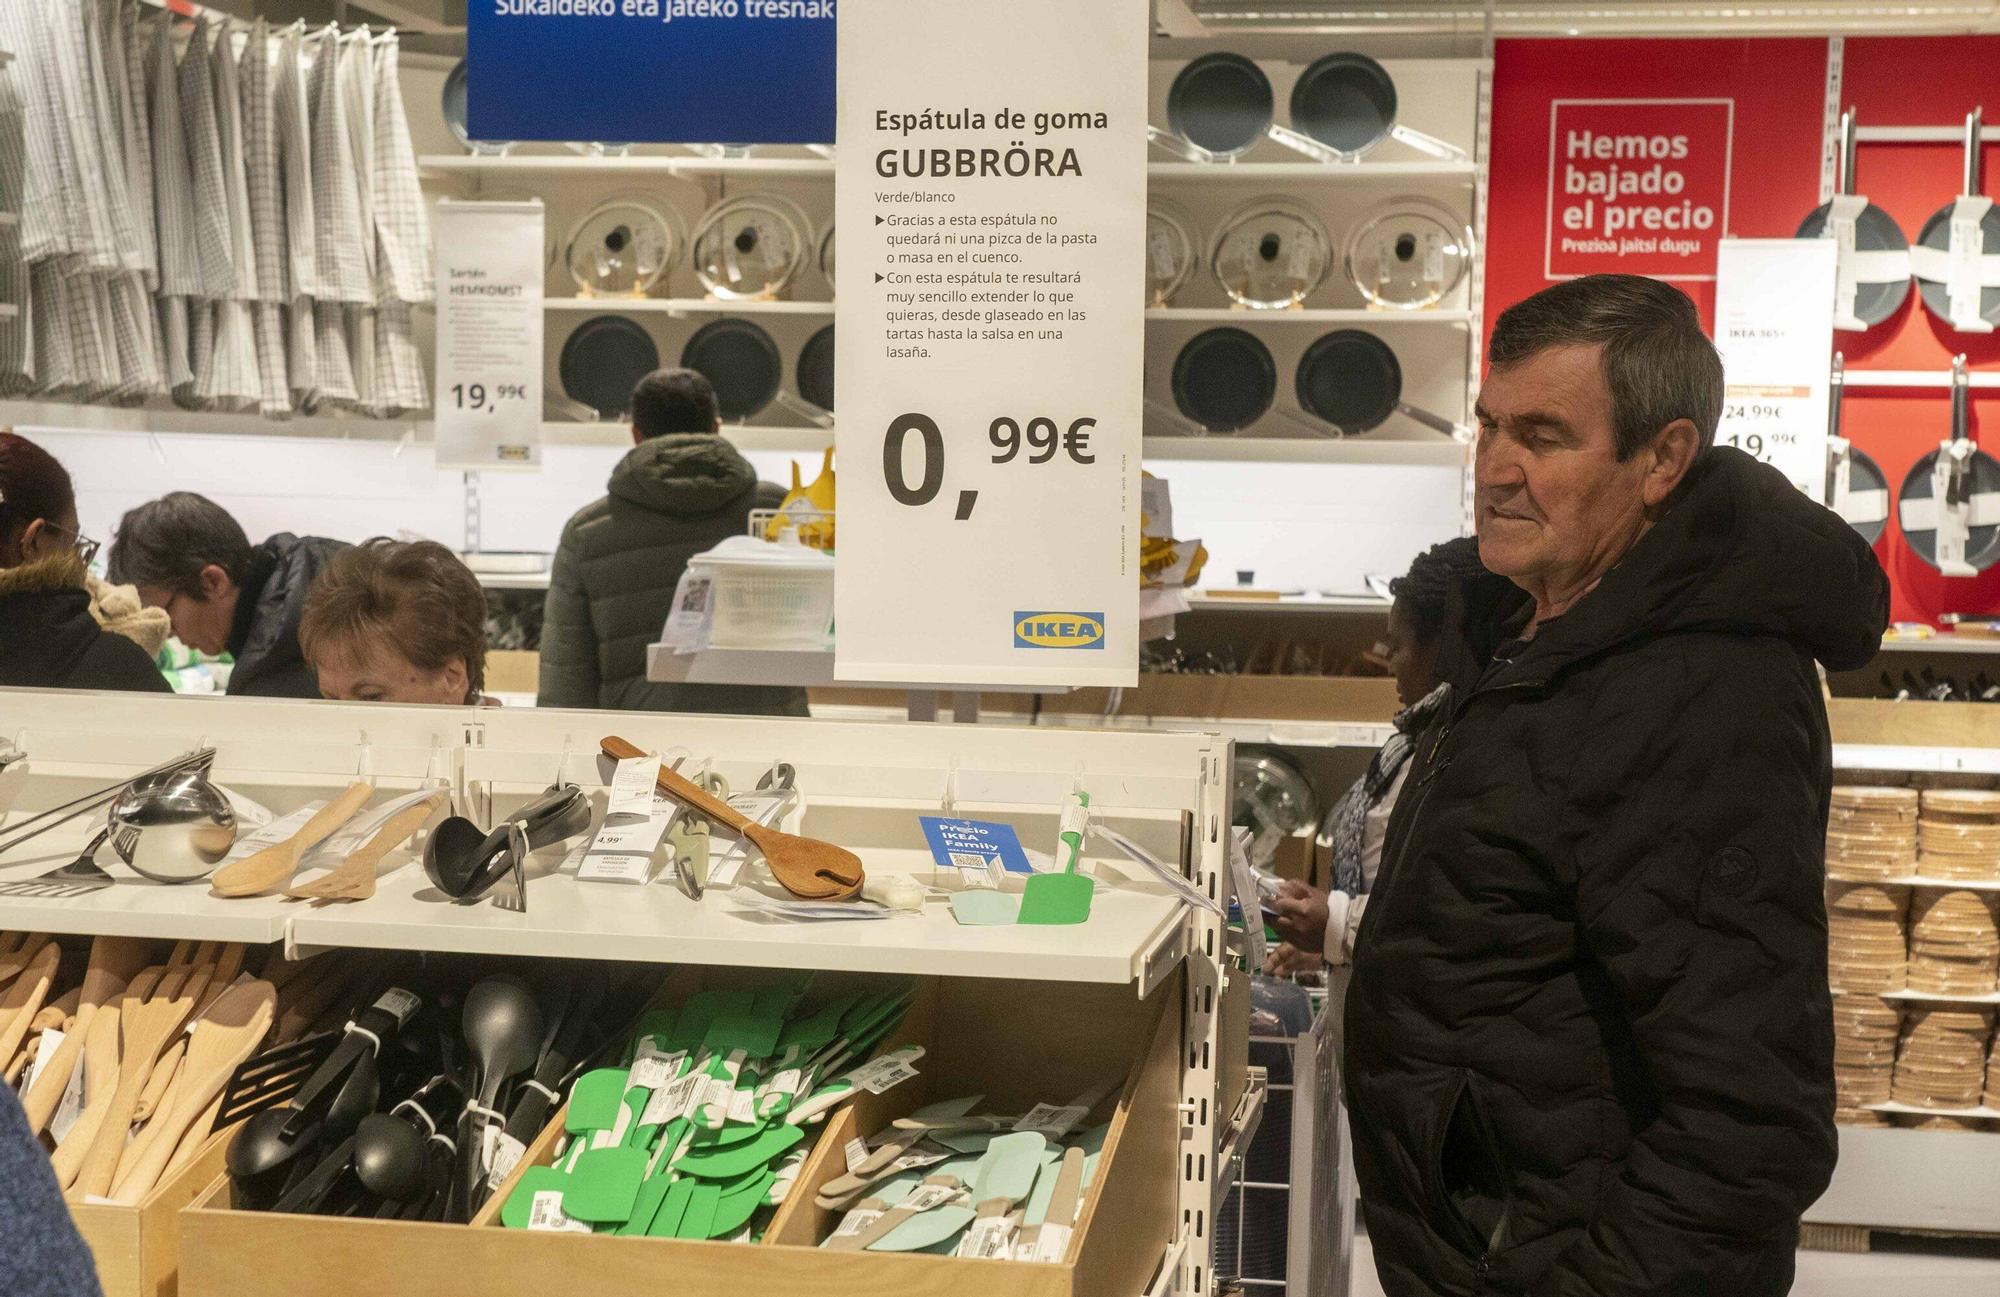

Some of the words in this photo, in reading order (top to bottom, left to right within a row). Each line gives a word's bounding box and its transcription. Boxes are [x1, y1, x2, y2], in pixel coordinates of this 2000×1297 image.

[621, 0, 659, 16] eta
[662, 0, 739, 22] jateko
[744, 0, 834, 19] tresnak
[876, 108, 986, 136] Espátula
[994, 108, 1026, 130] de
[1034, 112, 1108, 136] goma
[1567, 130, 1689, 159] Hemos
[875, 141, 1083, 178] GUBBRÖRA
[1565, 164, 1685, 203] bajado
[875, 191, 956, 203] Verde/blanco
[887, 214, 935, 226] Gracias
[938, 216, 946, 226] a
[949, 215, 977, 226] esta
[980, 212, 1037, 229] espátula
[1040, 216, 1058, 226] no
[1562, 199, 1594, 230] el
[1604, 200, 1715, 238] precio
[886, 232, 941, 248] quedará
[944, 232, 956, 245] ni
[960, 235, 985, 245] una
[989, 233, 1022, 248] pizca
[1025, 233, 1042, 245] de
[1046, 232, 1057, 245] la
[1061, 233, 1097, 248] pasta
[1561, 237, 1618, 253] Prezioa
[1618, 237, 1657, 257] jaitsi
[1659, 237, 1700, 257] dugu
[886, 254, 895, 264] o
[898, 254, 933, 264] masa
[937, 254, 953, 264] en
[957, 251, 968, 264] el
[972, 253, 1023, 264] cuenco.
[886, 271, 912, 284] Con
[915, 272, 943, 284] esta
[946, 271, 1002, 287] espátula
[1006, 273, 1019, 284] te
[1022, 271, 1081, 284] resultará
[886, 292, 915, 306] muy
[918, 290, 967, 303] sencillo
[971, 290, 1030, 303] extender
[1033, 290, 1045, 303] lo
[1048, 293, 1074, 306] que
[886, 309, 937, 324] quieras,
[941, 309, 981, 322] desde
[984, 309, 1044, 325] glaseado
[1047, 311, 1064, 322] en
[1068, 309, 1086, 322] las
[886, 328, 924, 341] tartas
[927, 327, 963, 340] hasta
[967, 327, 978, 340] la
[981, 327, 1014, 340] salsa
[1018, 330, 1034, 340] en
[1038, 330, 1063, 340] una
[1729, 329, 1757, 338] IKEA
[886, 345, 931, 359] lasaña.
[1023, 622, 1098, 638] IKEA
[942, 832, 979, 842] IKEA
[945, 839, 998, 851] Family
